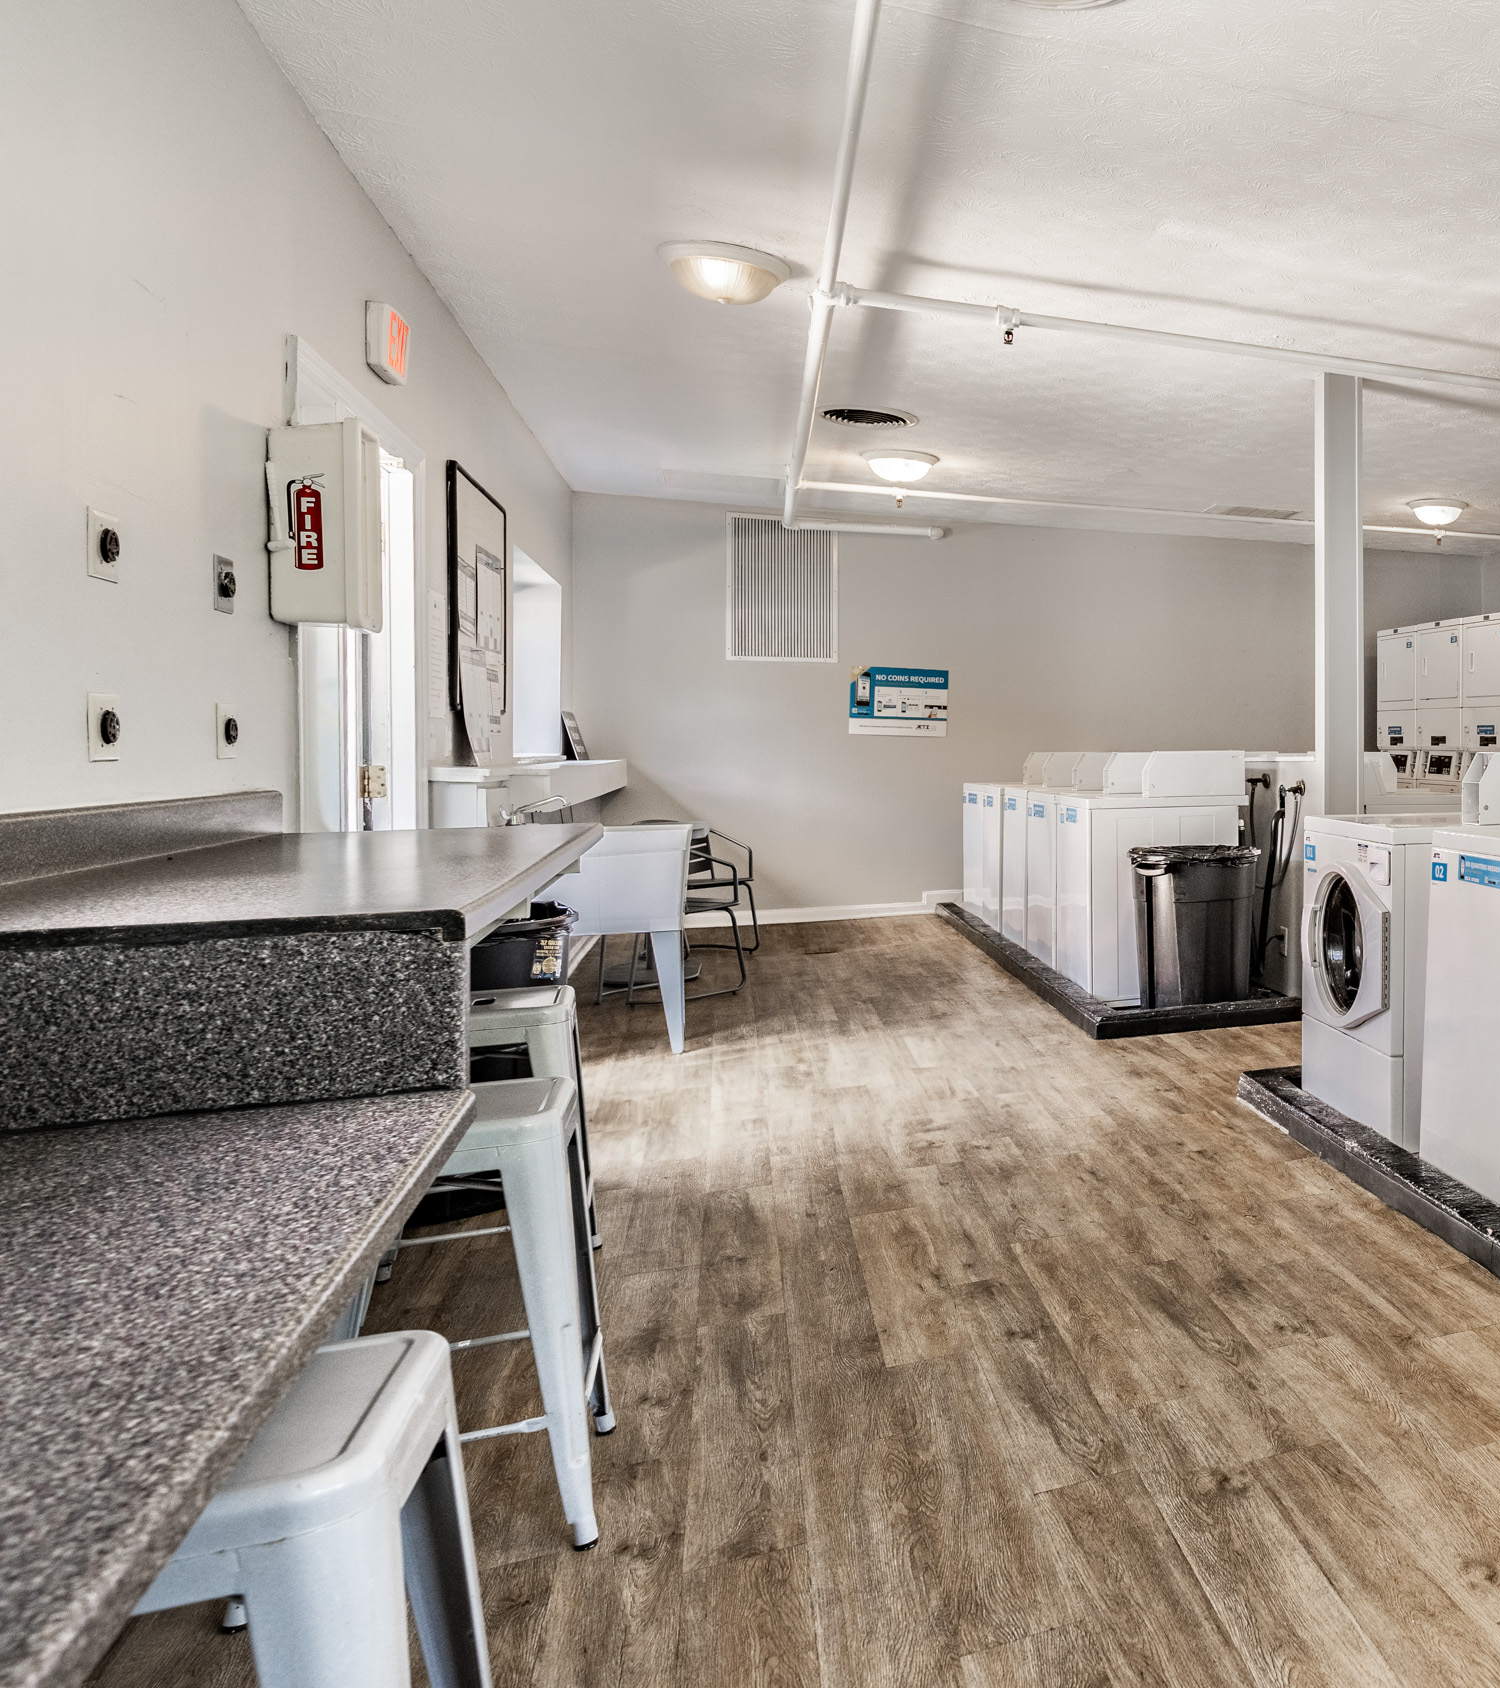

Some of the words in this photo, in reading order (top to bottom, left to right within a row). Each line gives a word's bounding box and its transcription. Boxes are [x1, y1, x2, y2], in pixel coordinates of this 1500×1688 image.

[388, 311, 409, 377] EXIT
[300, 497, 318, 565] FIRE
[1307, 846, 1313, 858] 01
[1435, 865, 1444, 878] 02
